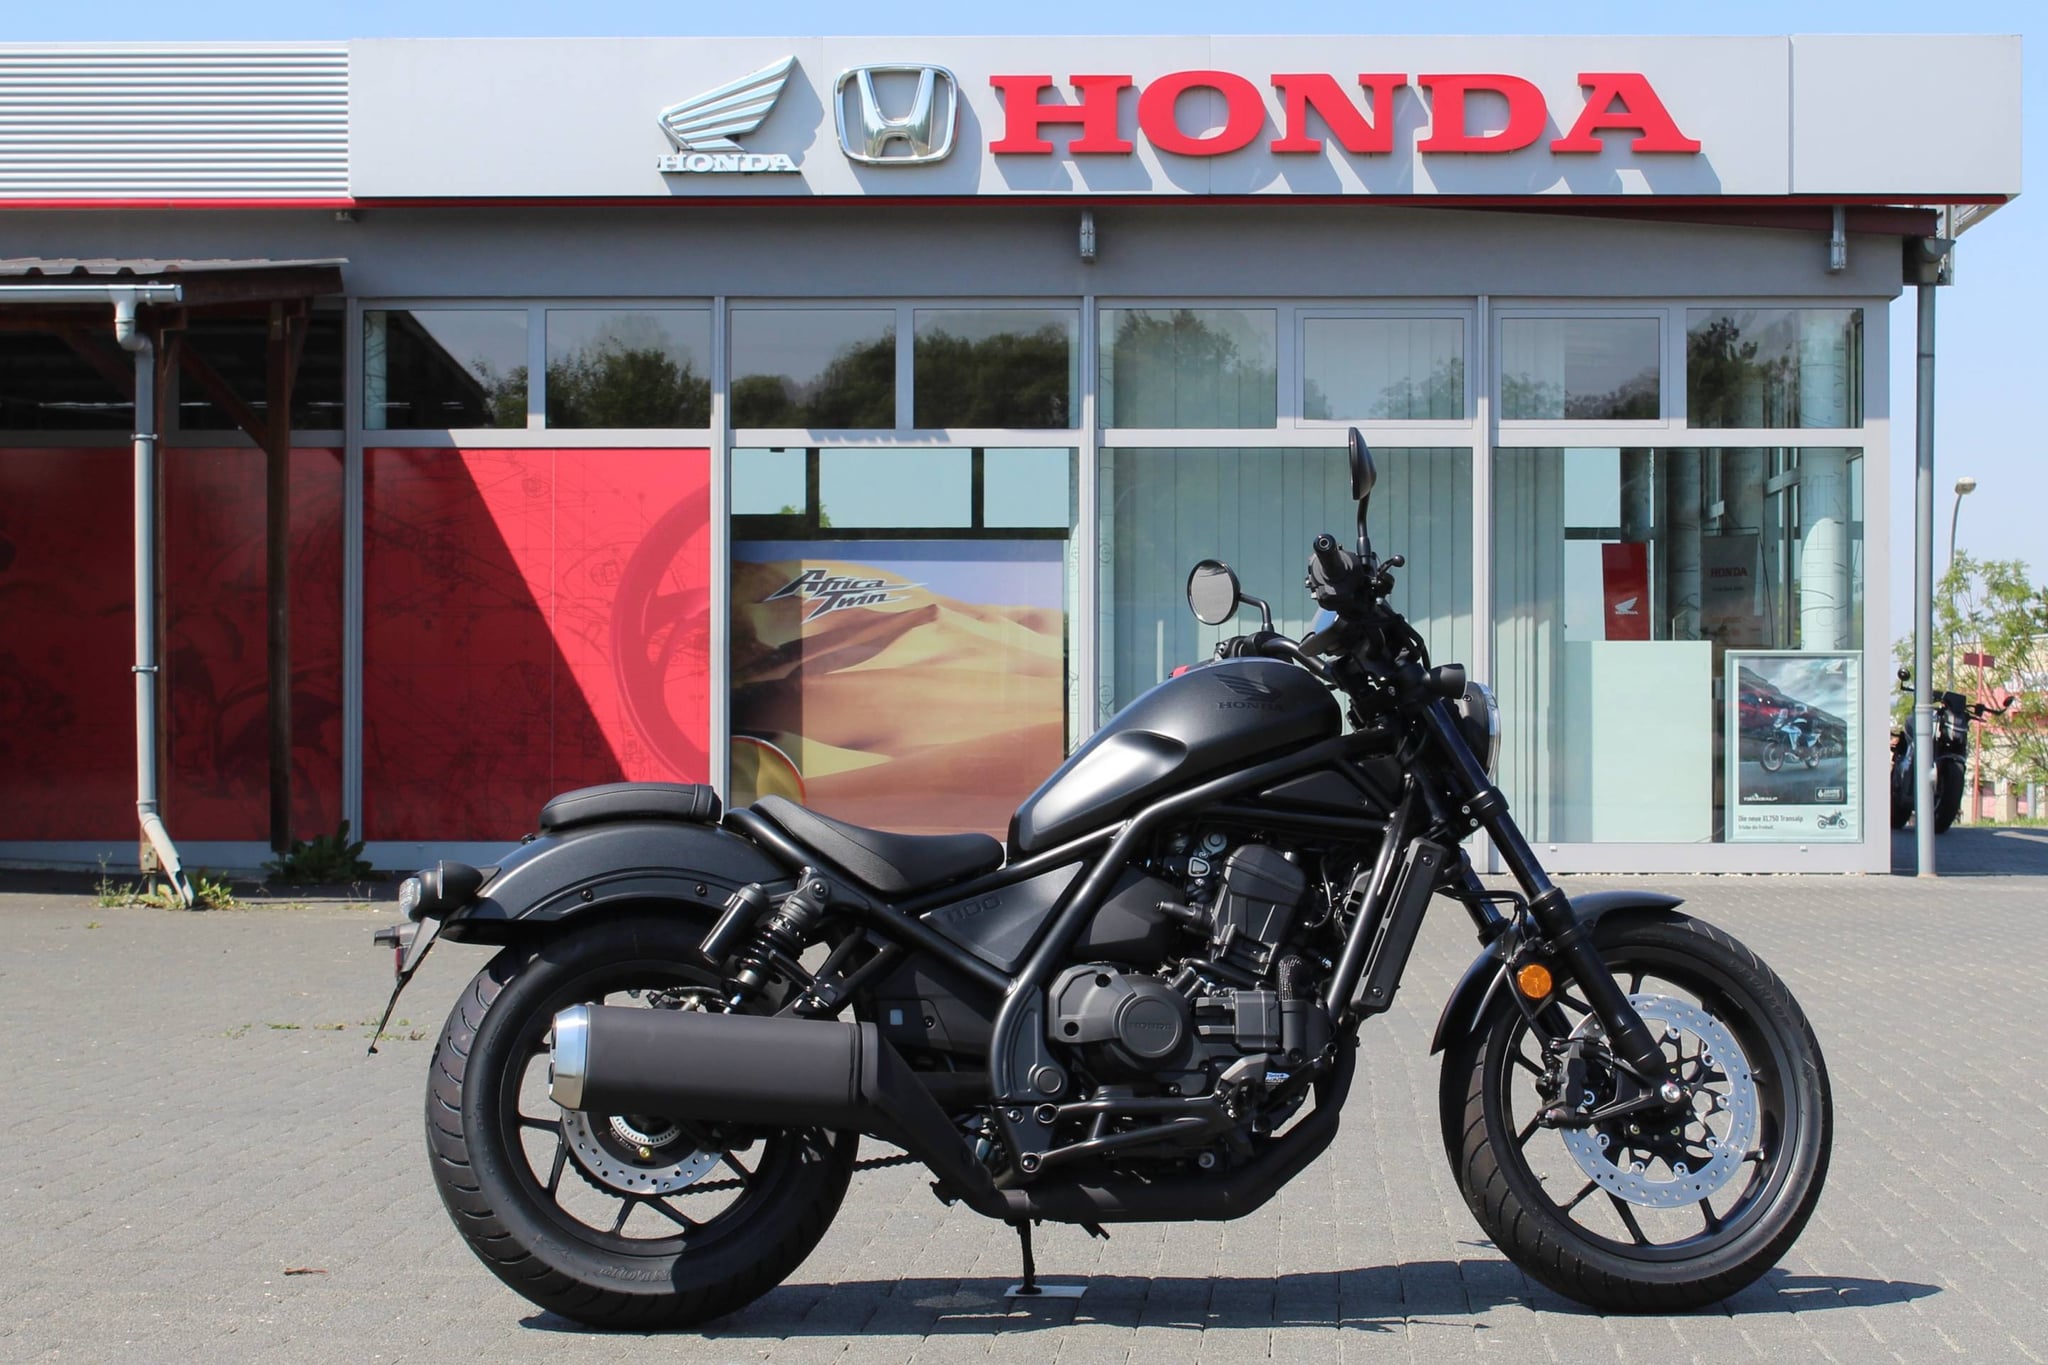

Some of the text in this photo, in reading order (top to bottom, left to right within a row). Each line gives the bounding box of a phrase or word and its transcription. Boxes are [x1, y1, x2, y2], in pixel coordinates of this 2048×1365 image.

[989, 70, 1702, 156] HONDA
[657, 153, 801, 173] HONDA
[763, 567, 928, 603] Africa
[801, 589, 912, 625] Twin
[1218, 701, 1284, 712] HONDA
[942, 896, 1002, 922] 1100
